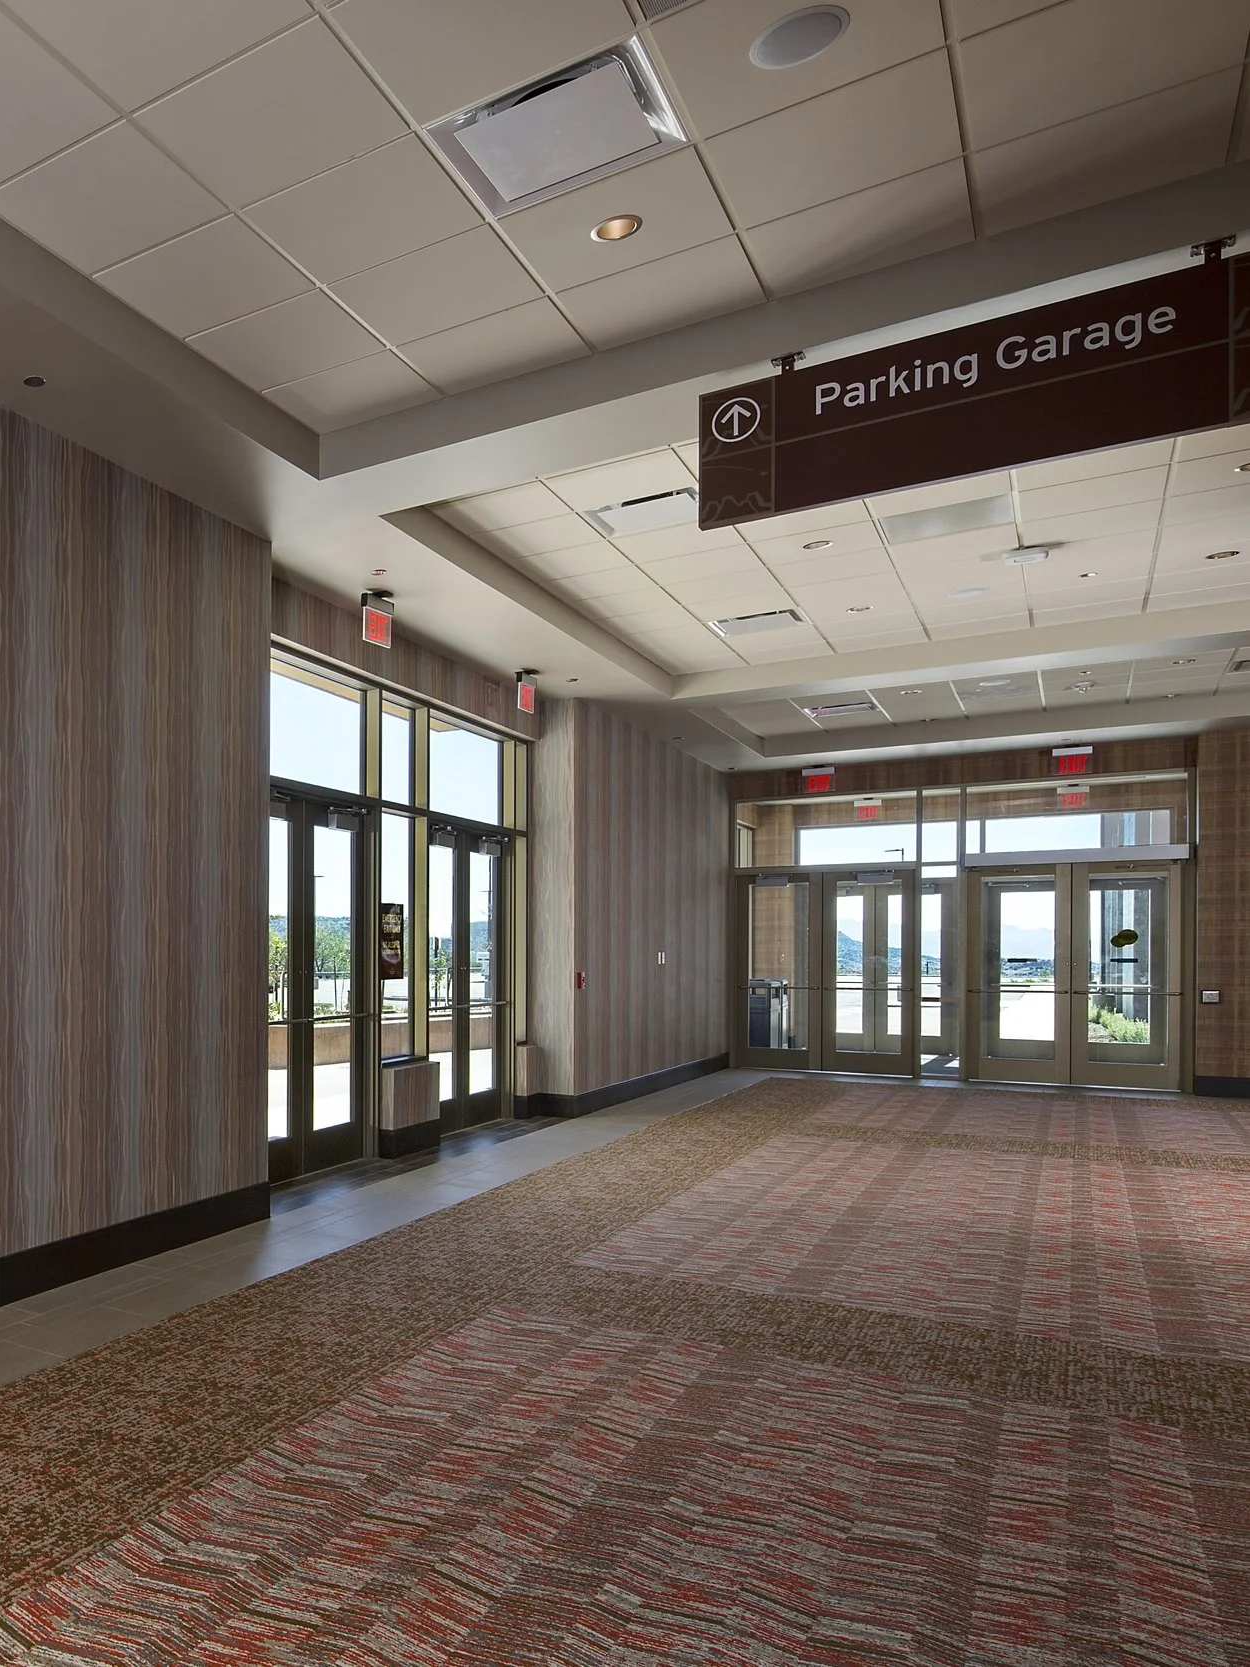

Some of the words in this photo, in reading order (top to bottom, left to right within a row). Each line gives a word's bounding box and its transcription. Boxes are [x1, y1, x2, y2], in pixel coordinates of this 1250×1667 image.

[815, 351, 978, 414] Parking
[996, 306, 1176, 369] Garage
[368, 611, 387, 644] EXIT
[1059, 755, 1087, 773] EXIT
[807, 774, 830, 791] EXIT
[1063, 793, 1086, 808] EXIT
[858, 805, 878, 820] EXIT
